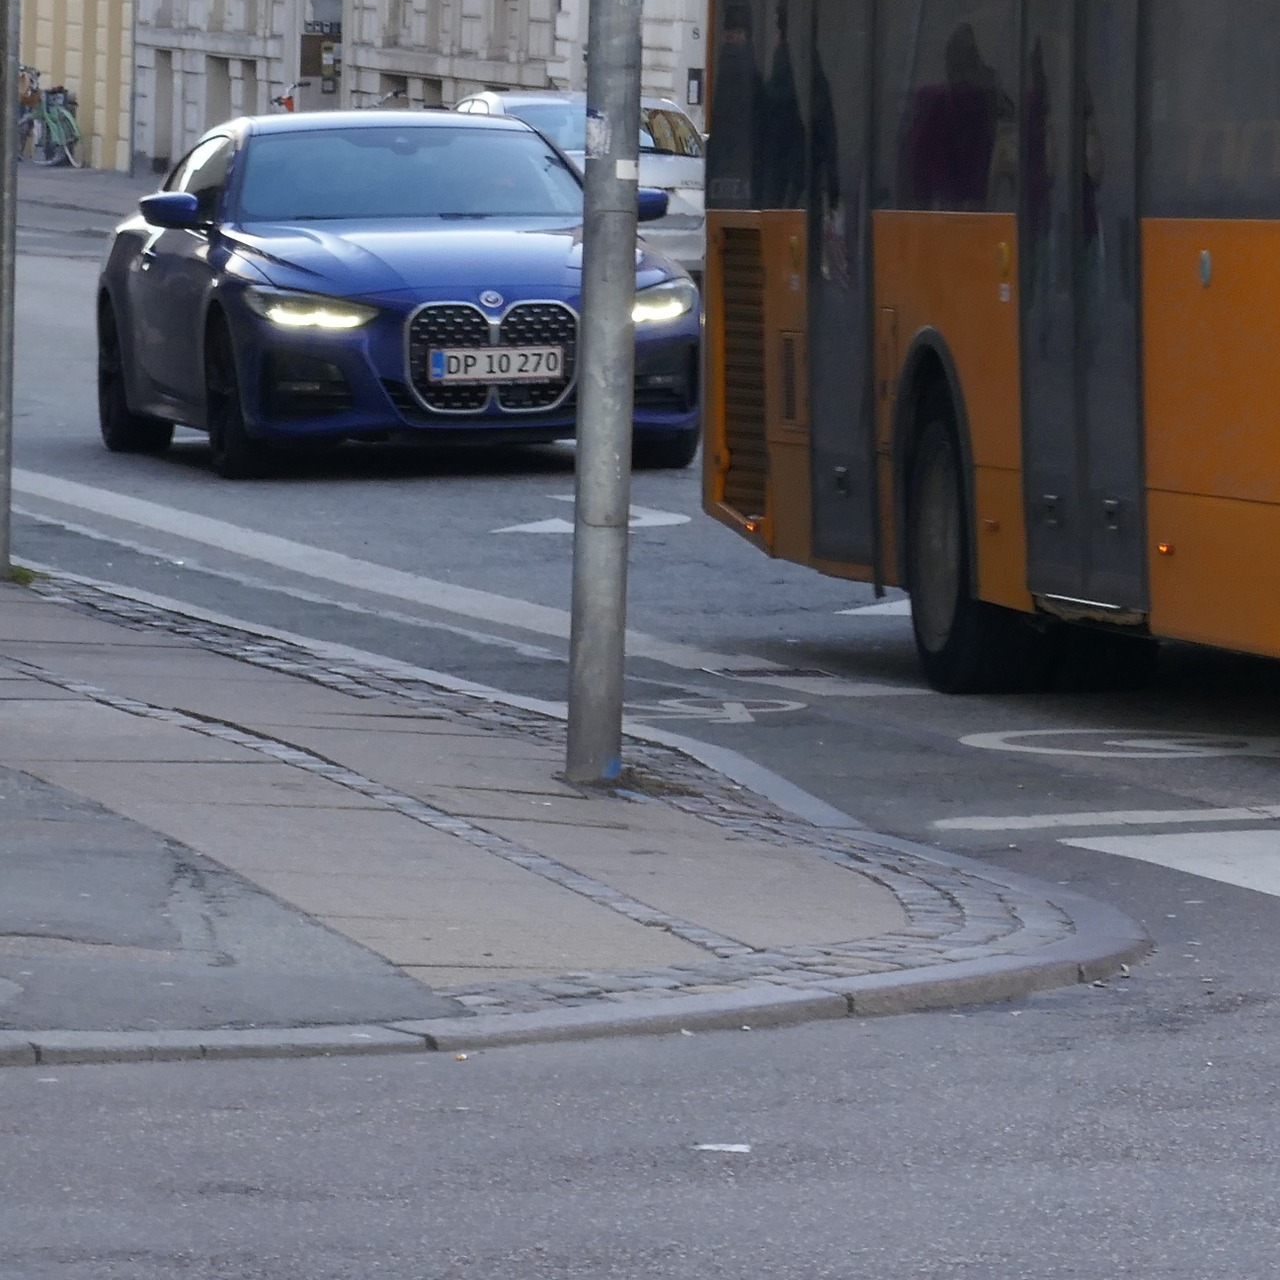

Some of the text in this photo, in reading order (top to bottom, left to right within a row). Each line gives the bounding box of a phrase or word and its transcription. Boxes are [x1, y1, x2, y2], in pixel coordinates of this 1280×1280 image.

[446, 354, 477, 375] DP
[485, 354, 511, 374] 10
[518, 352, 559, 373] 270
